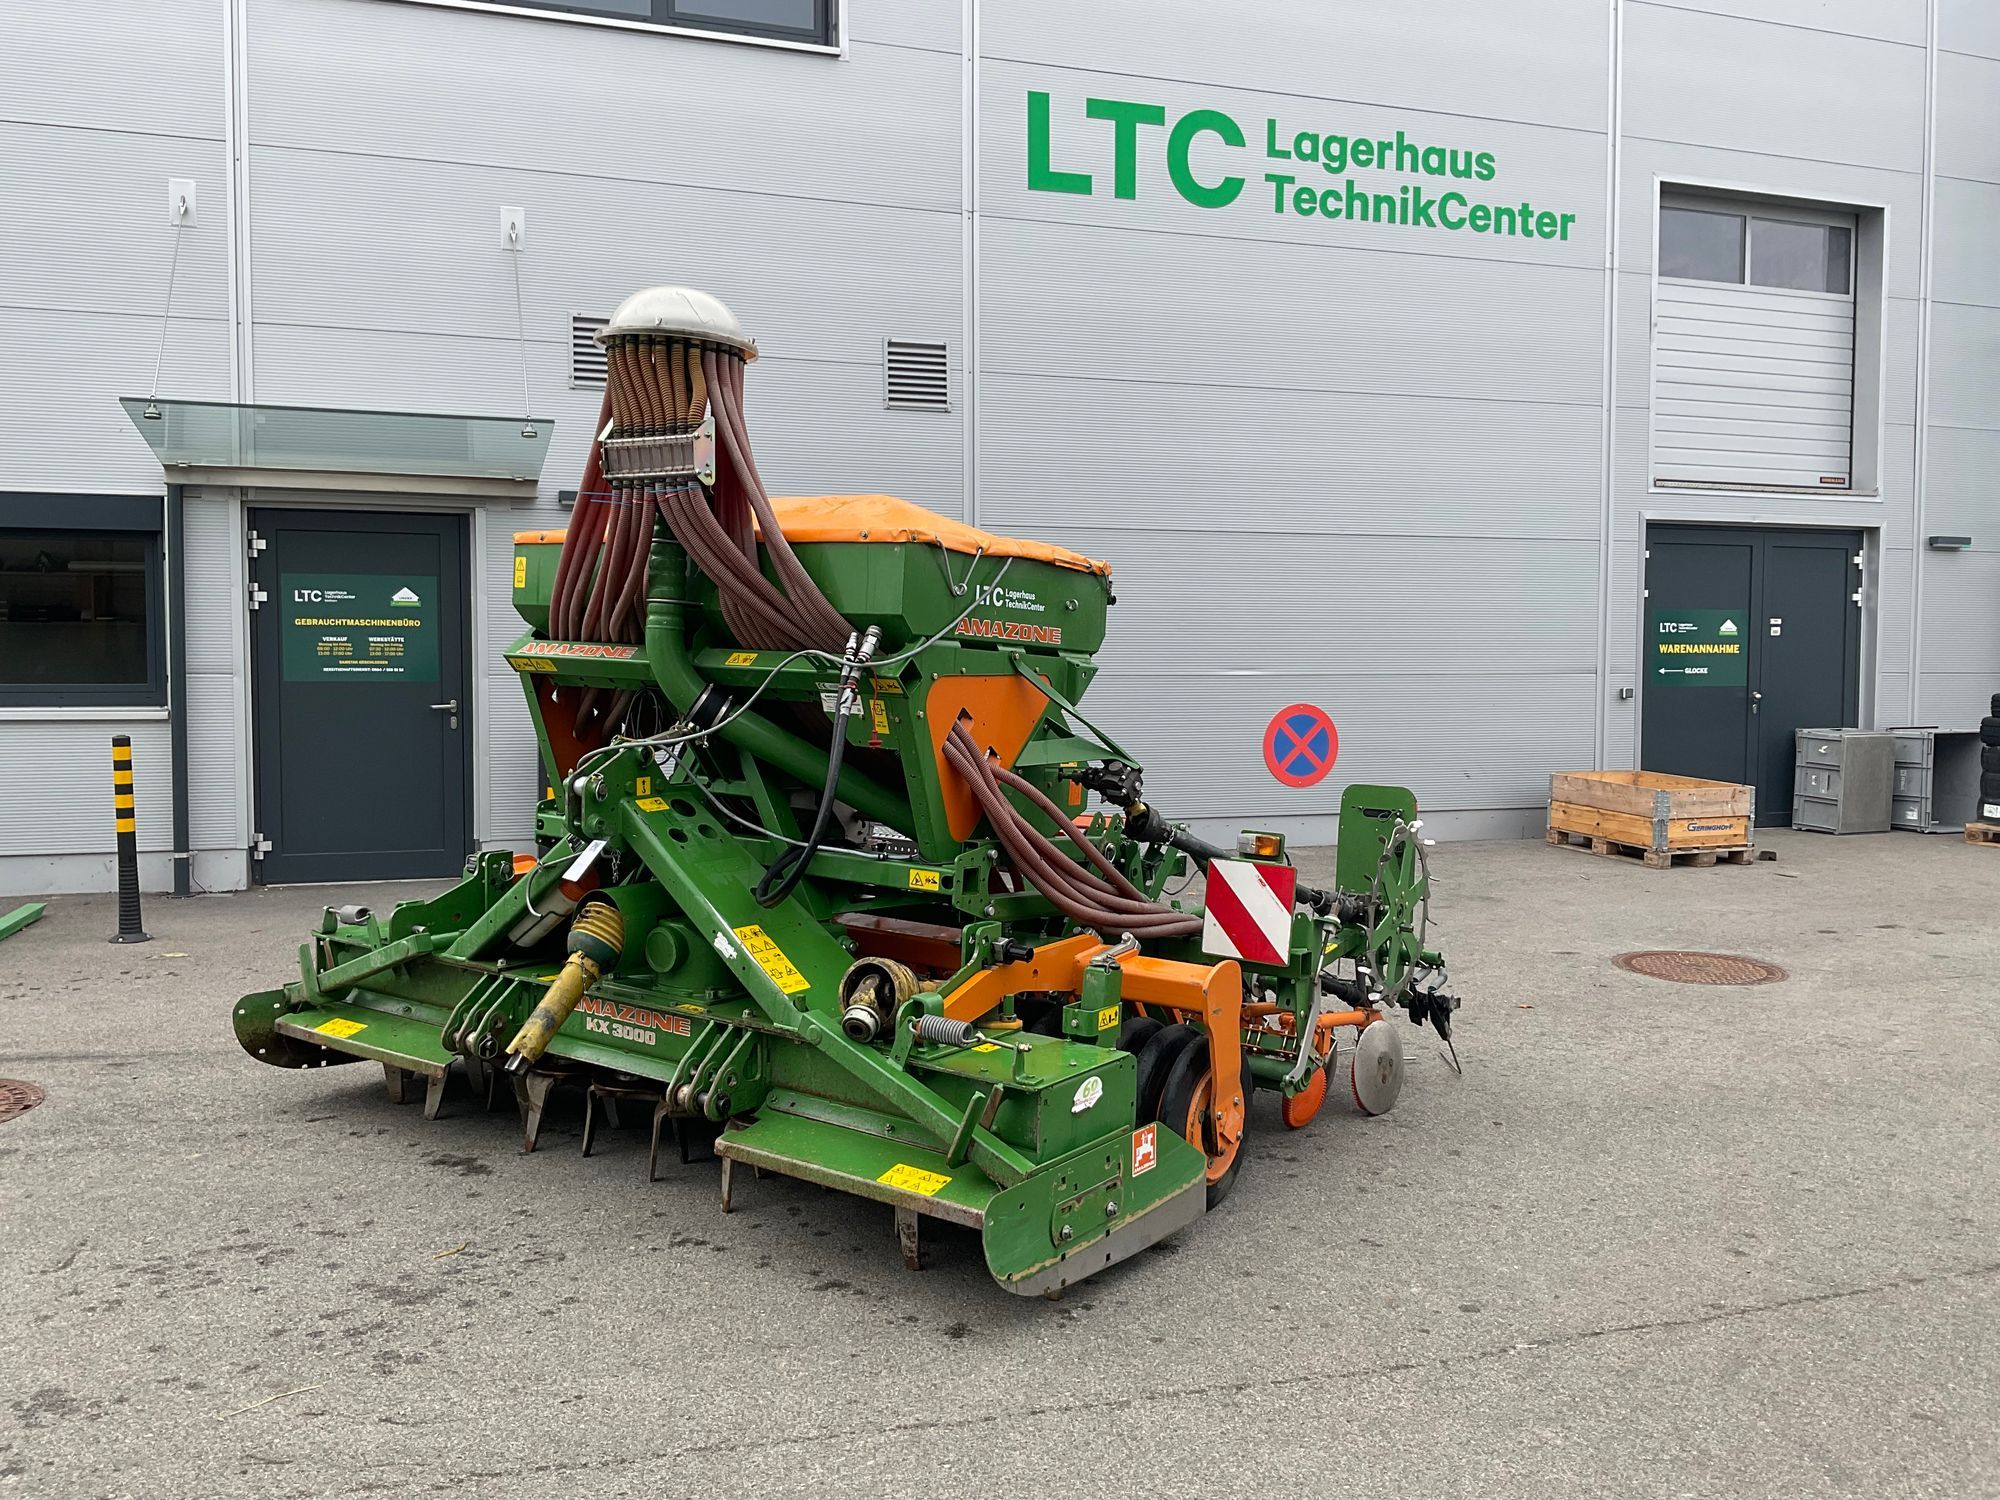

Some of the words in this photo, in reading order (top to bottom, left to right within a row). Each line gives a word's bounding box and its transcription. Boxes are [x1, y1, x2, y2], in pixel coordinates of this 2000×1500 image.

[1027, 90, 1246, 209] LTC
[1266, 118, 1496, 181] Lagerhaus
[1264, 173, 1575, 241] TechnikCenter
[294, 590, 322, 602] LTC
[975, 585, 1004, 607] LTC
[1005, 588, 1035, 600] Lagerhaus
[1005, 599, 1045, 612] TechnikCenter
[294, 618, 421, 627] GEBRAUCHTMASCHINENBÜRO
[1660, 622, 1678, 633] LTC
[955, 617, 1062, 644] AMAZONE
[516, 642, 638, 659] AMAZONE
[1659, 644, 1740, 654] WARENANNAHME
[1687, 822, 1733, 832] GERINGHOFF
[587, 1017, 609, 1035] KX
[612, 1023, 656, 1046] 3000
